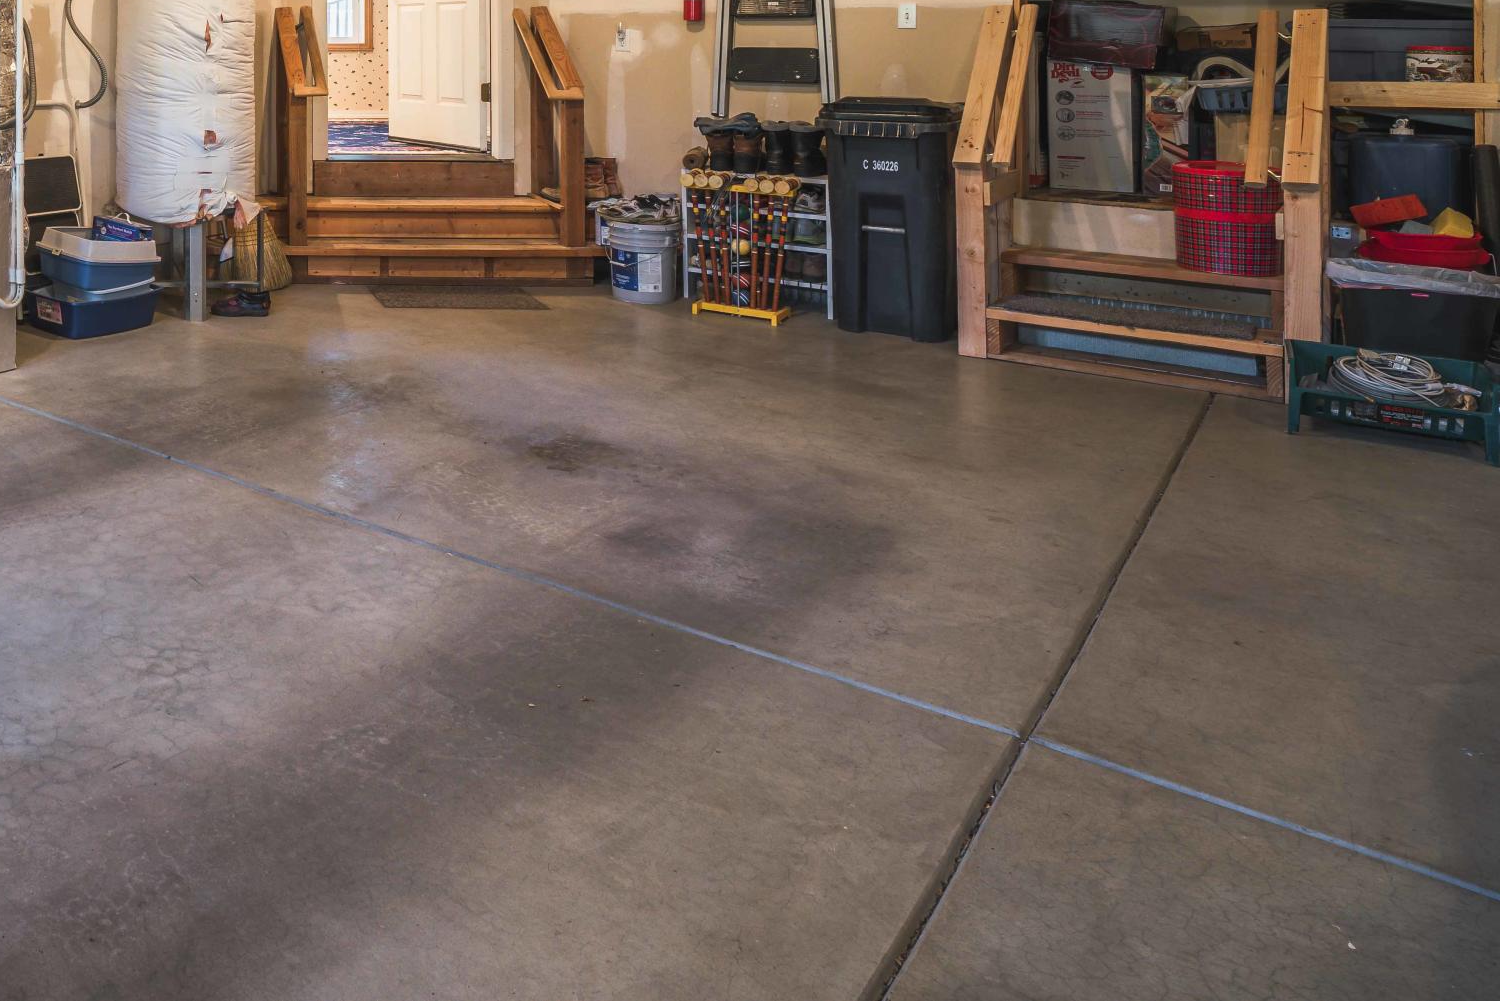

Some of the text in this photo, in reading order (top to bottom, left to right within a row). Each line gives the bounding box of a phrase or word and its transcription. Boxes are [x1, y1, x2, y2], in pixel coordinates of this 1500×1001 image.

[1053, 62, 1076, 71] Dirt
[1051, 69, 1080, 81] Devil
[863, 159, 869, 170] C
